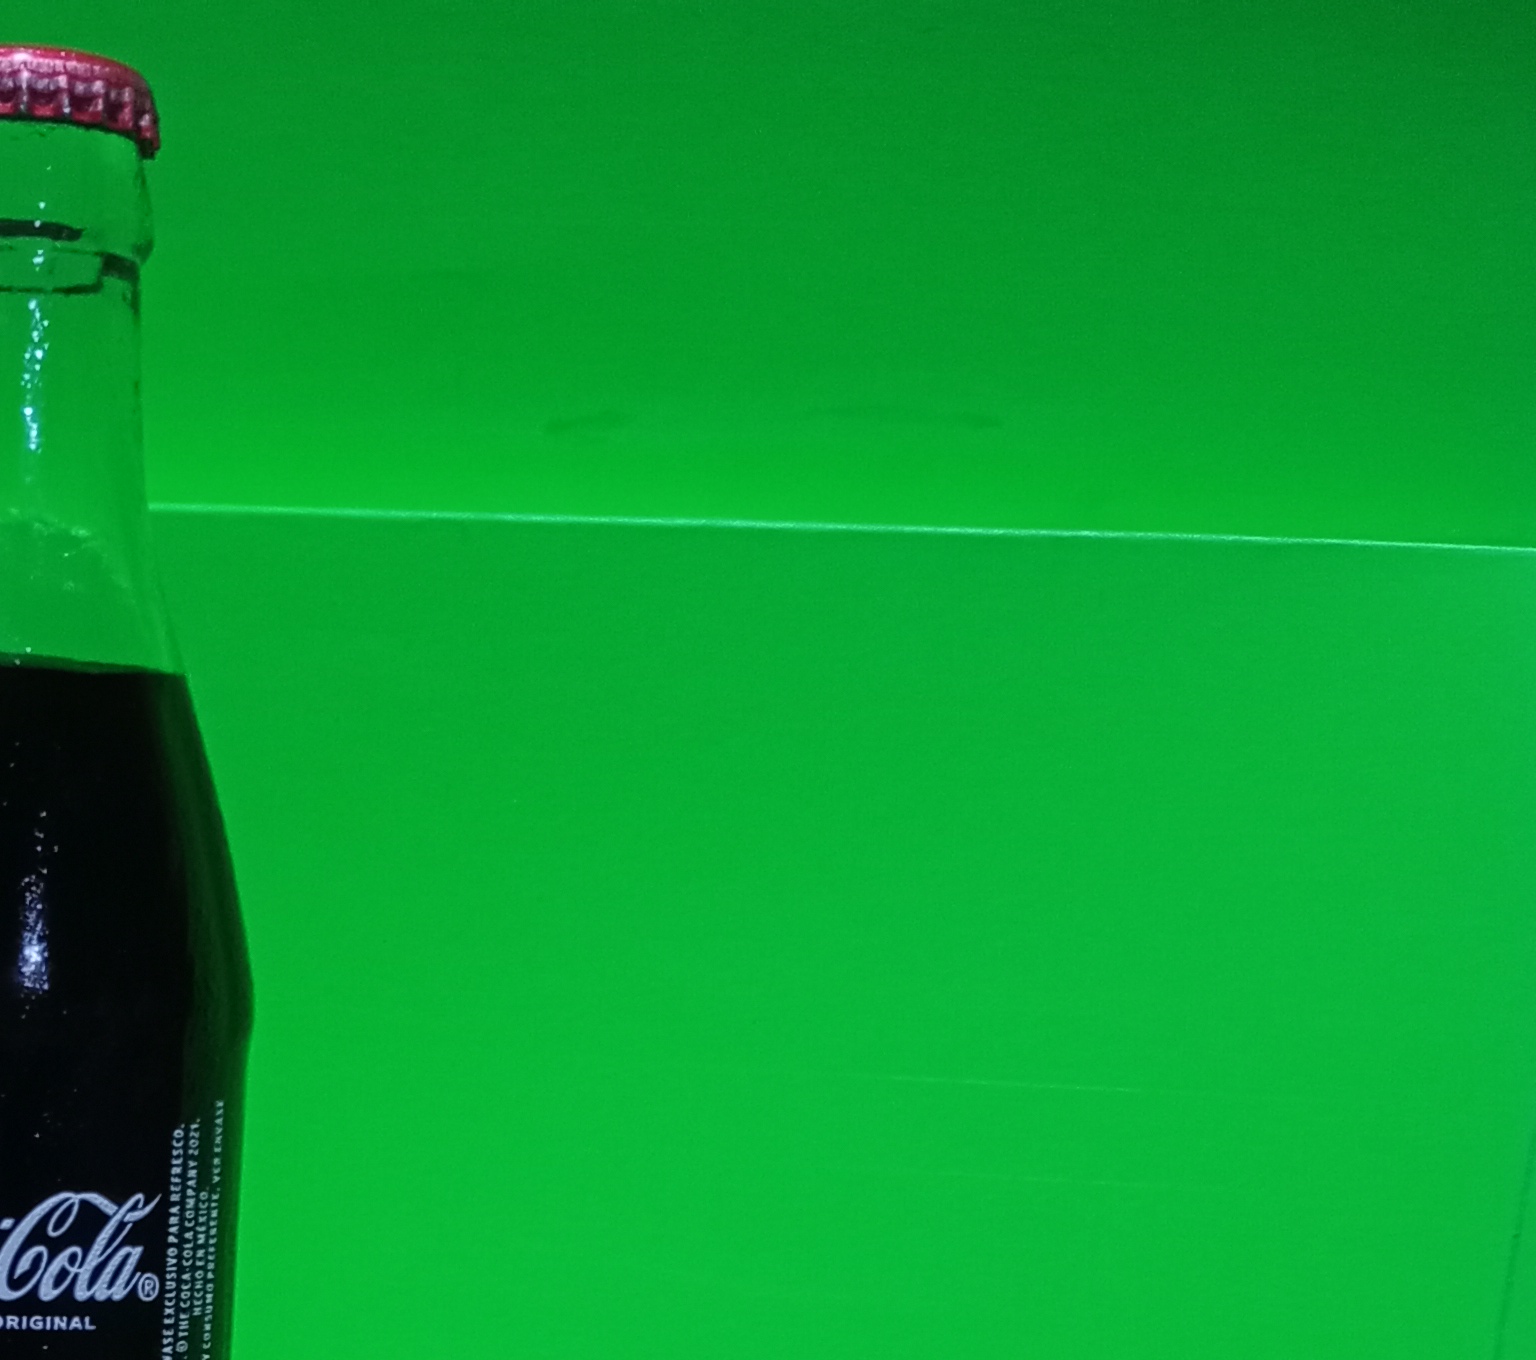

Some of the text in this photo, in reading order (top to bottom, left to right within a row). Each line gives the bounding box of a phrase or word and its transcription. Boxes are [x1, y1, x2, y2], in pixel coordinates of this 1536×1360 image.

[170, 1124, 185, 1202] REFRESCO.
[168, 1206, 181, 1244] PARA
[179, 1312, 190, 1337] THE
[185, 1160, 198, 1228] COMPANY
[196, 1249, 205, 1267] EN
[163, 1248, 178, 1324] EXCLUSIVO
[193, 1270, 204, 1316] HECHO
[203, 1283, 214, 1349] CONSUMO
